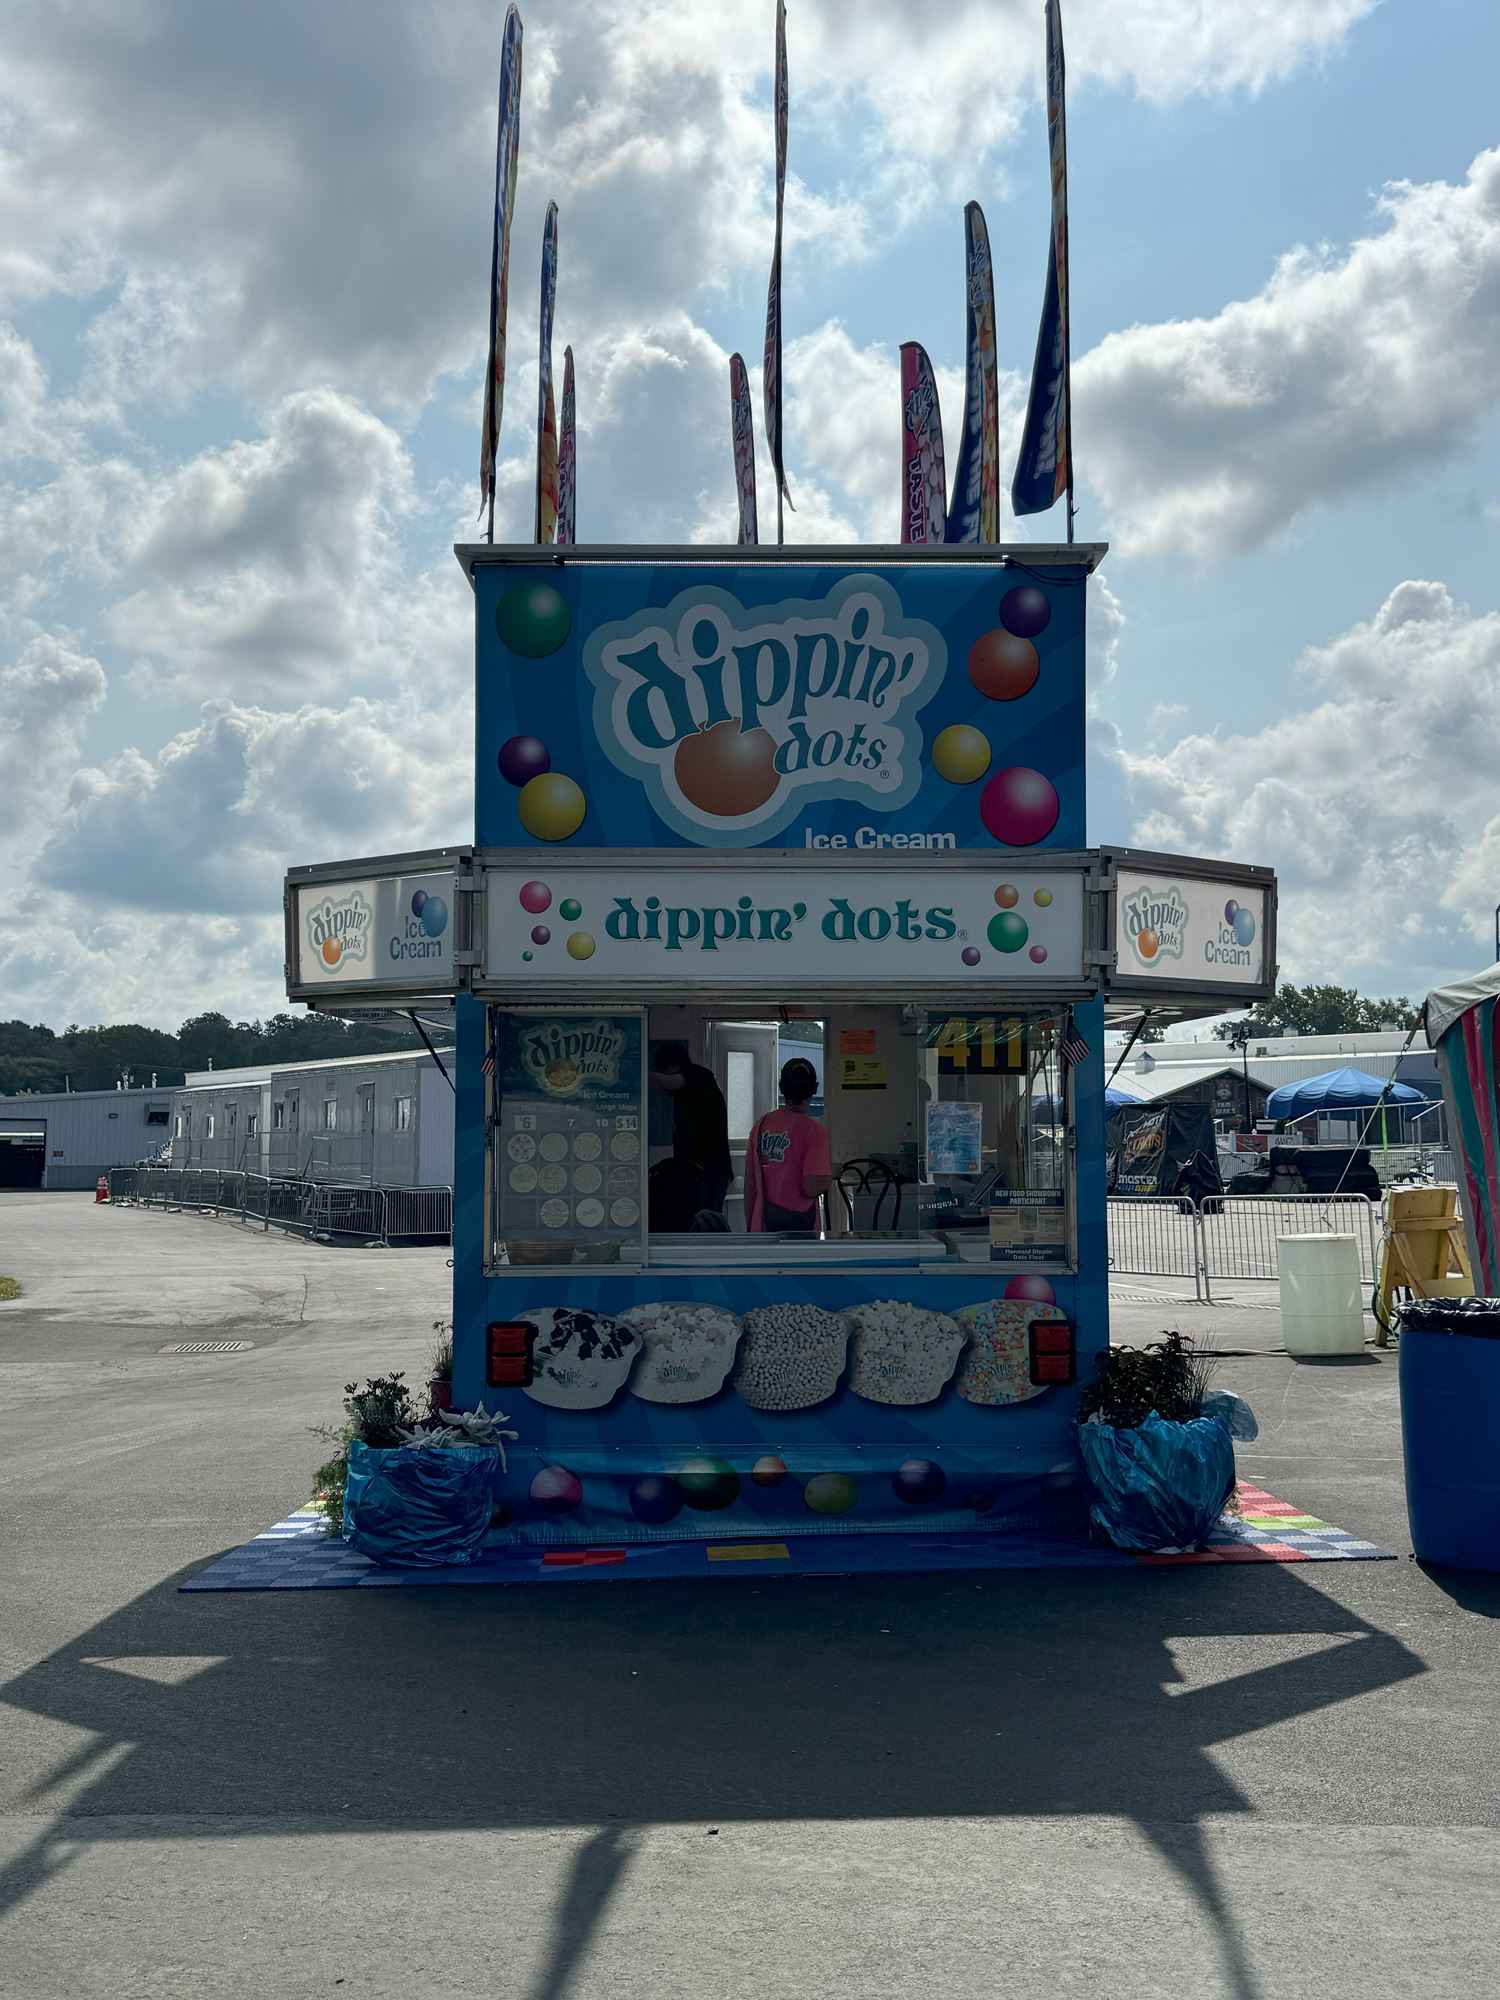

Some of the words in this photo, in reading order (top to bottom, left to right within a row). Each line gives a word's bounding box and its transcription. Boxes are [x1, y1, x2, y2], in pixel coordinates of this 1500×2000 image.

[909, 451, 926, 542] TASTE
[616, 607, 916, 749] dippin'
[775, 722, 888, 774] dots
[805, 827, 847, 848] Ice
[855, 827, 956, 848] Cream
[312, 900, 367, 946] dippin'
[405, 915, 427, 939] Ice
[605, 895, 807, 952] dippin'
[821, 897, 958, 942] dots
[1128, 896, 1184, 936] dippin'
[341, 935, 362, 951] dots
[1158, 930, 1178, 947] dots
[1219, 921, 1238, 945] Ice
[390, 937, 442, 960] Cream
[1204, 940, 1251, 966] Cream
[528, 1026, 617, 1067] dippin'
[935, 1017, 1022, 1068] 411
[577, 1058, 609, 1075] dots
[599, 1089, 630, 1100] Cream
[595, 1119, 609, 1127] 10
